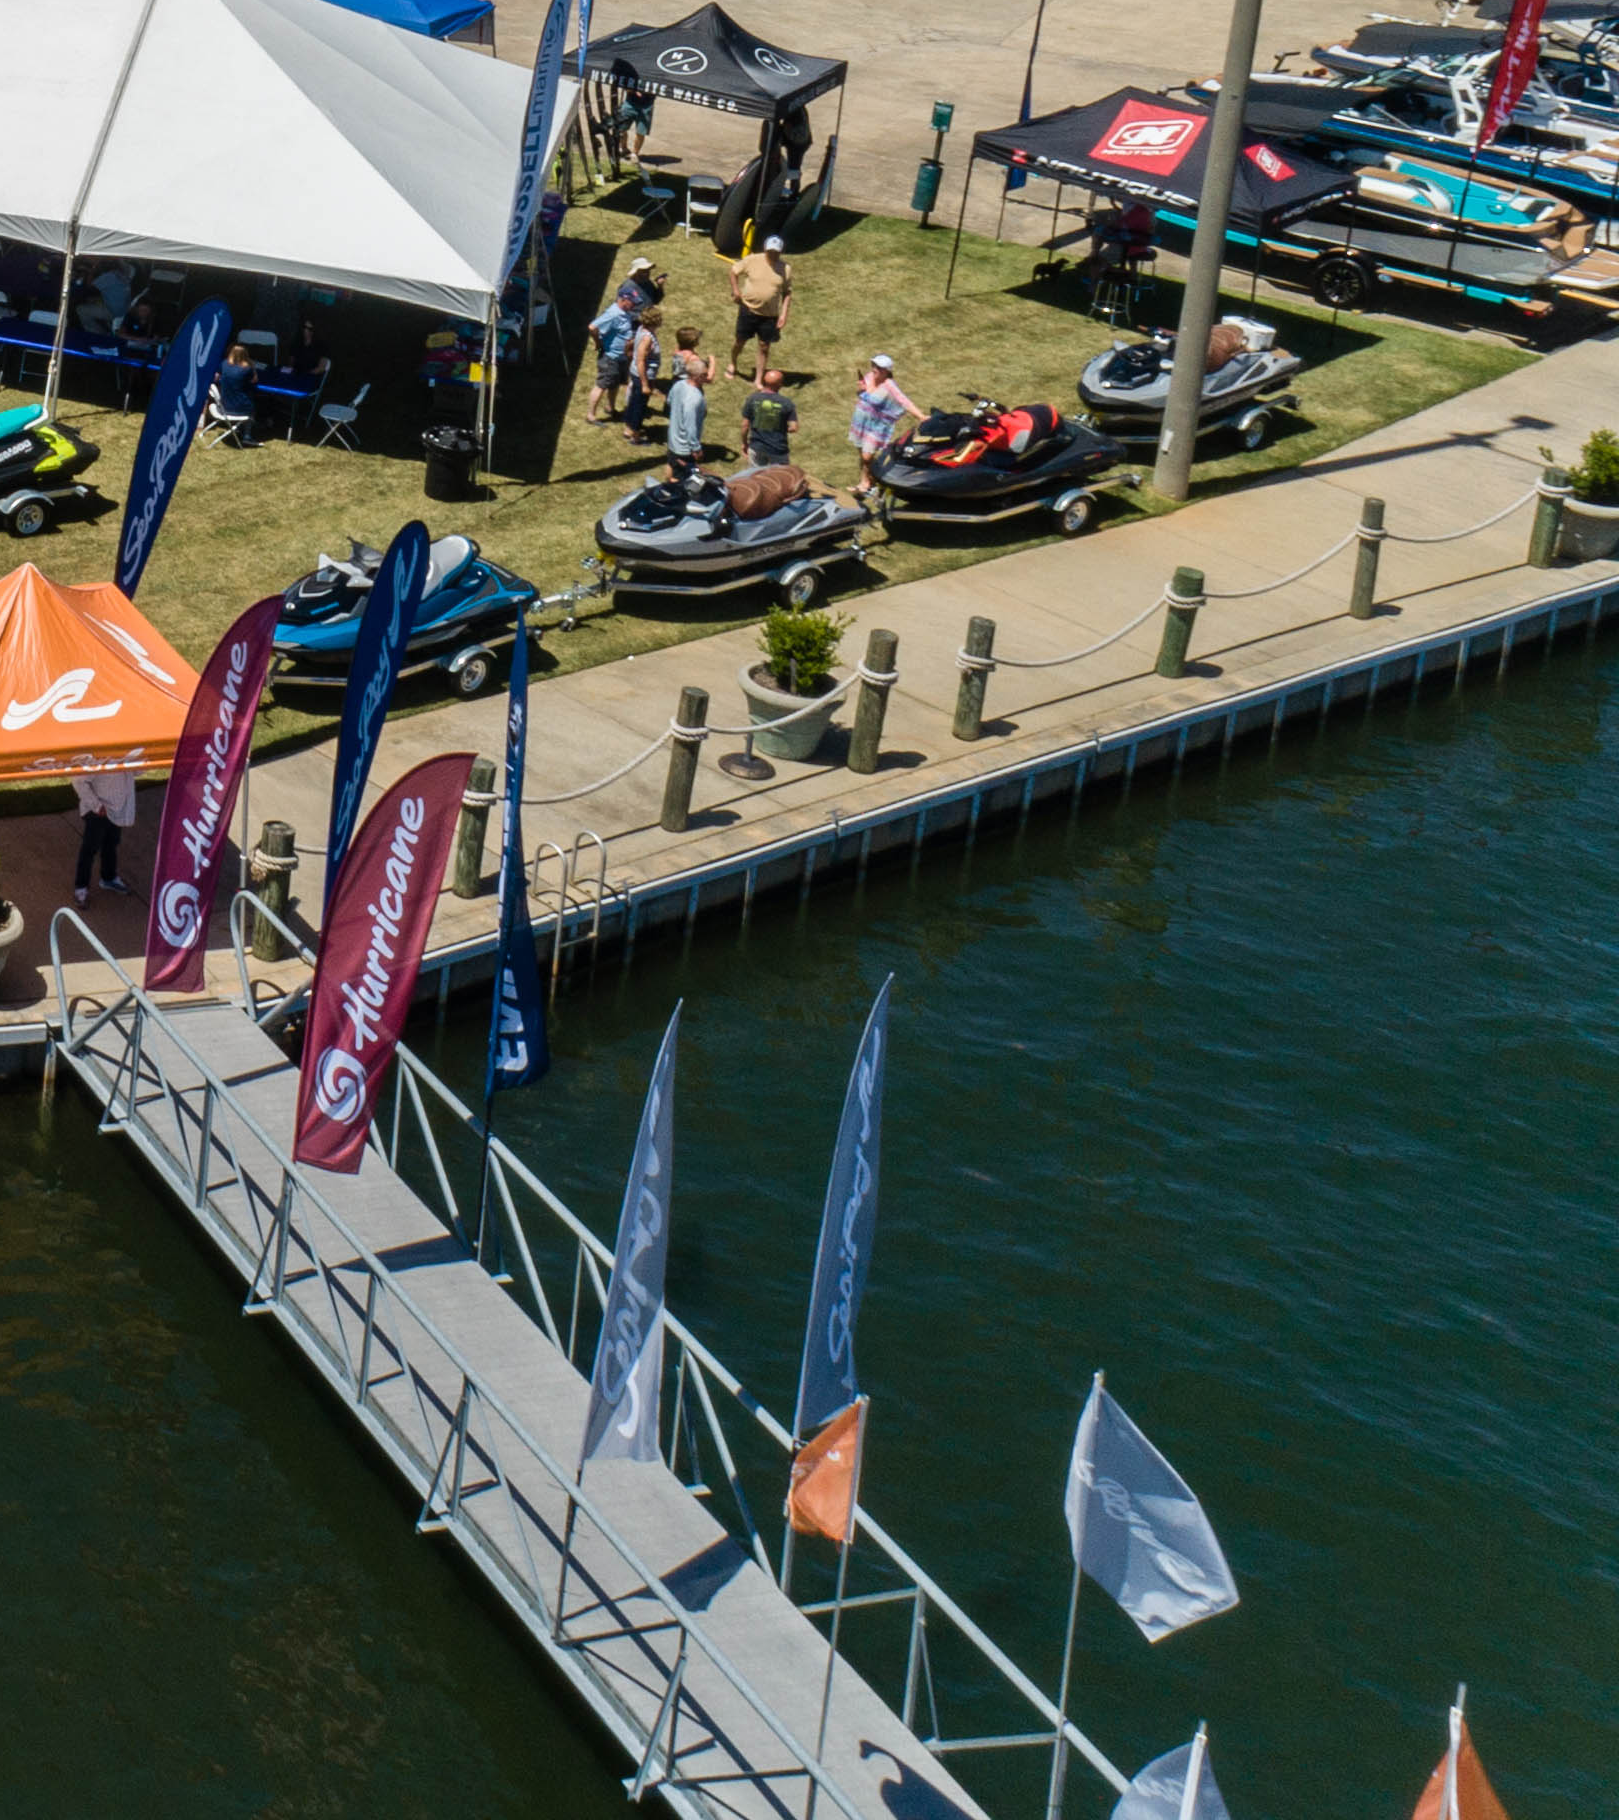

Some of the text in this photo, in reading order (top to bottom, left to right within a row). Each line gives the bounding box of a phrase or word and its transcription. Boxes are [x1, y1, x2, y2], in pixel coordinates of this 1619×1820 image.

[590, 69, 739, 113] HYPERLITE WAKE CO.
[186, 639, 249, 879] Hurricane
[342, 796, 427, 1055] Hurricane
